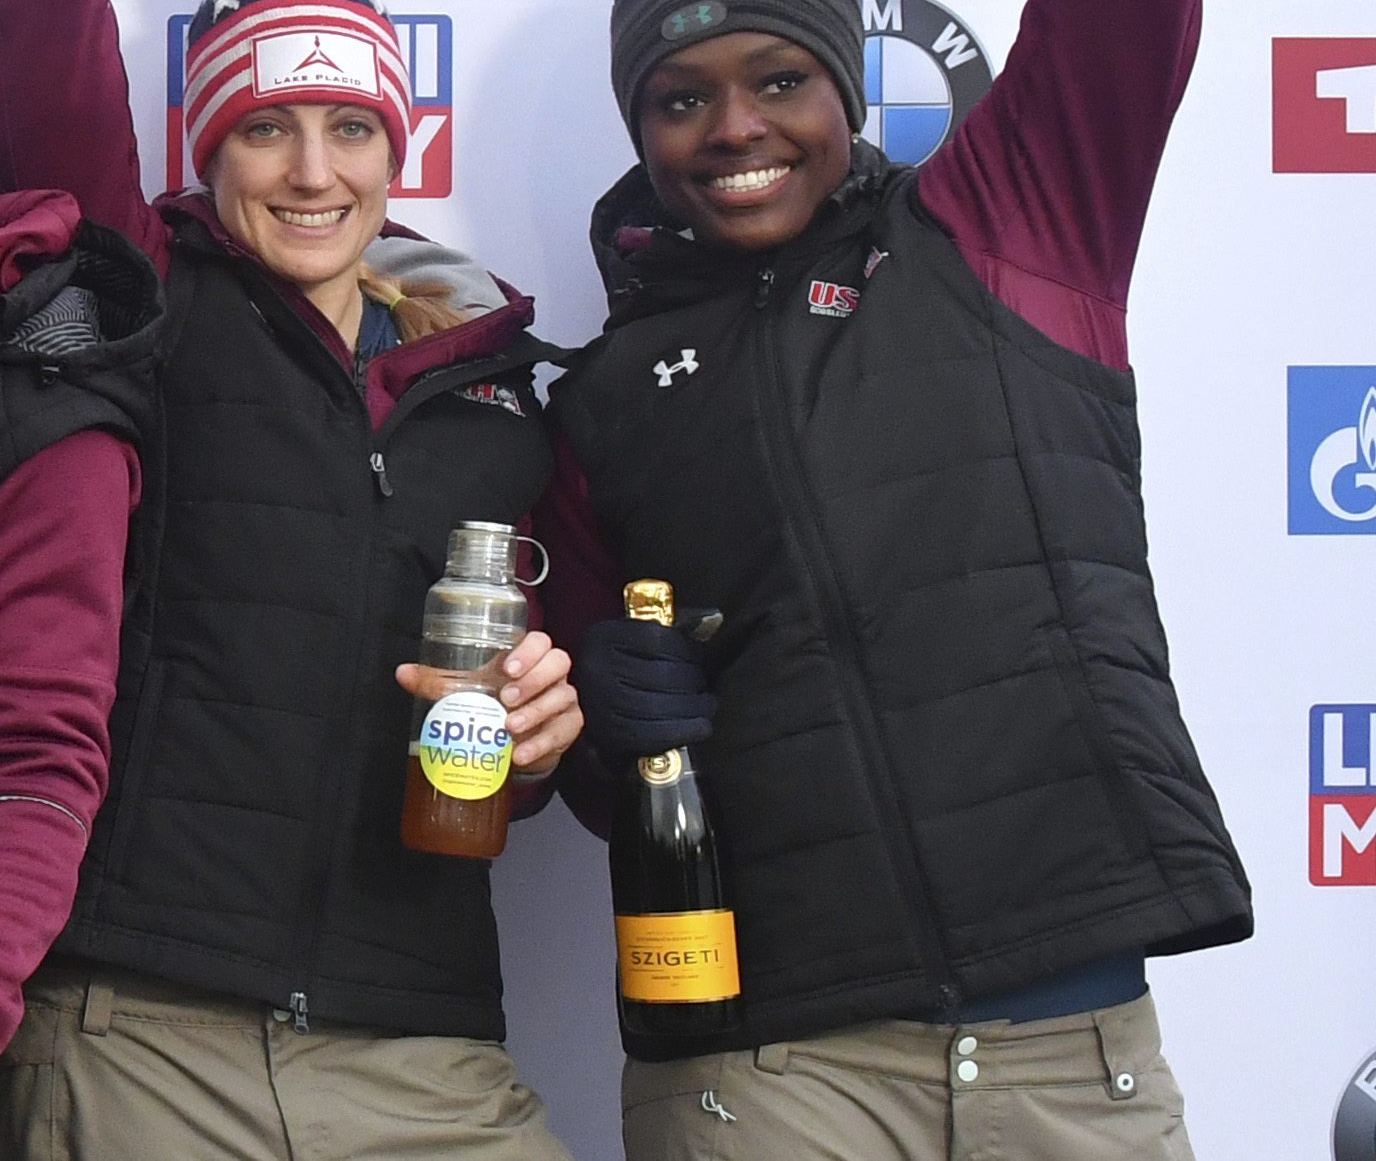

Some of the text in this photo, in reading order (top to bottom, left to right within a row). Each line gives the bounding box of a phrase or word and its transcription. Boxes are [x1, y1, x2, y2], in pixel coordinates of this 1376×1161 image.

[274, 74, 362, 86] LAKE PLACID
[428, 717, 509, 748] spice
[427, 745, 506, 773] water
[631, 948, 720, 967] SZIGETI
